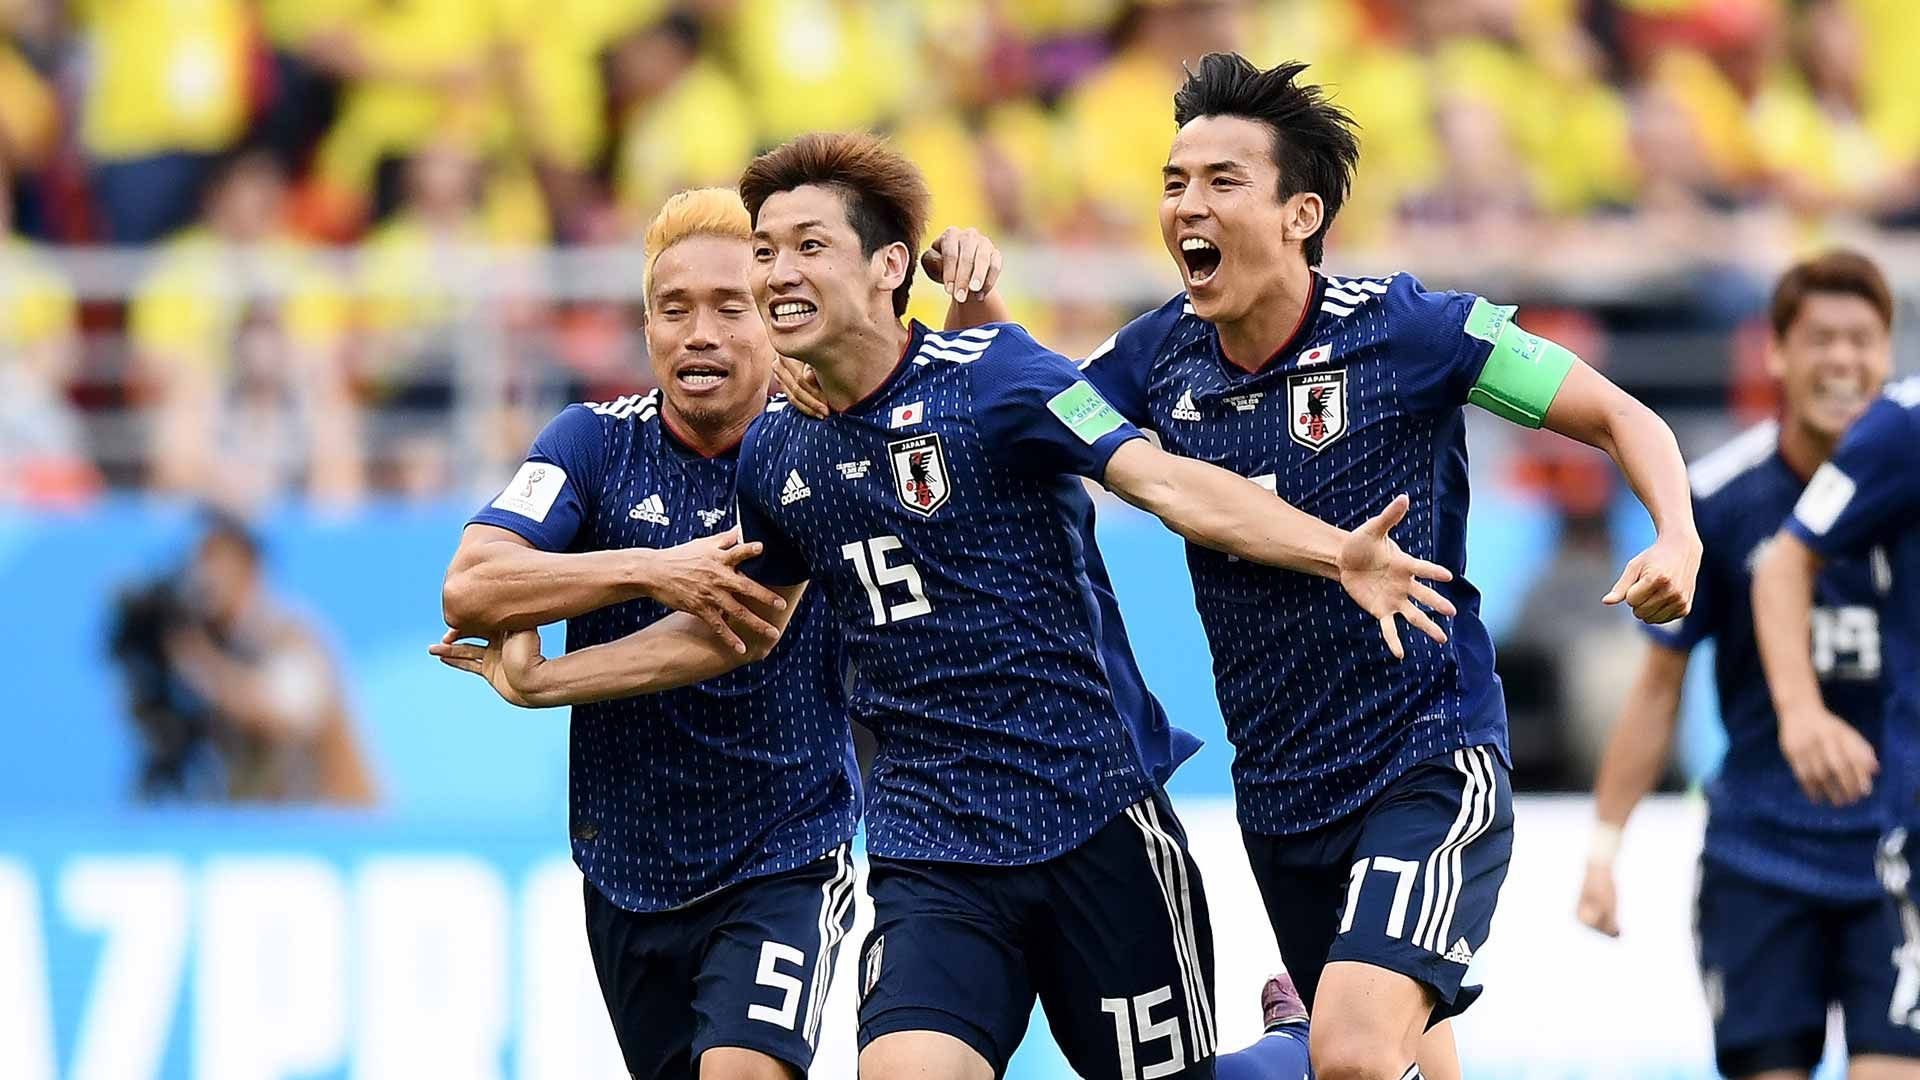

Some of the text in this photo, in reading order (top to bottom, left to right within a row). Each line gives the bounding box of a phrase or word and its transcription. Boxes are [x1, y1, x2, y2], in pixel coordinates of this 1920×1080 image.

[1301, 374, 1332, 384] JAPAN
[1171, 408, 1202, 422] adidas
[1305, 423, 1329, 437] JFA
[901, 439, 926, 451] JAPAN
[780, 486, 811, 506] adidas
[914, 489, 936, 503] JFA
[629, 508, 671, 526] adidas
[841, 535, 932, 626] 15
[1338, 856, 1420, 939] 17
[747, 940, 805, 1031] 5
[1101, 984, 1186, 1080] 15
